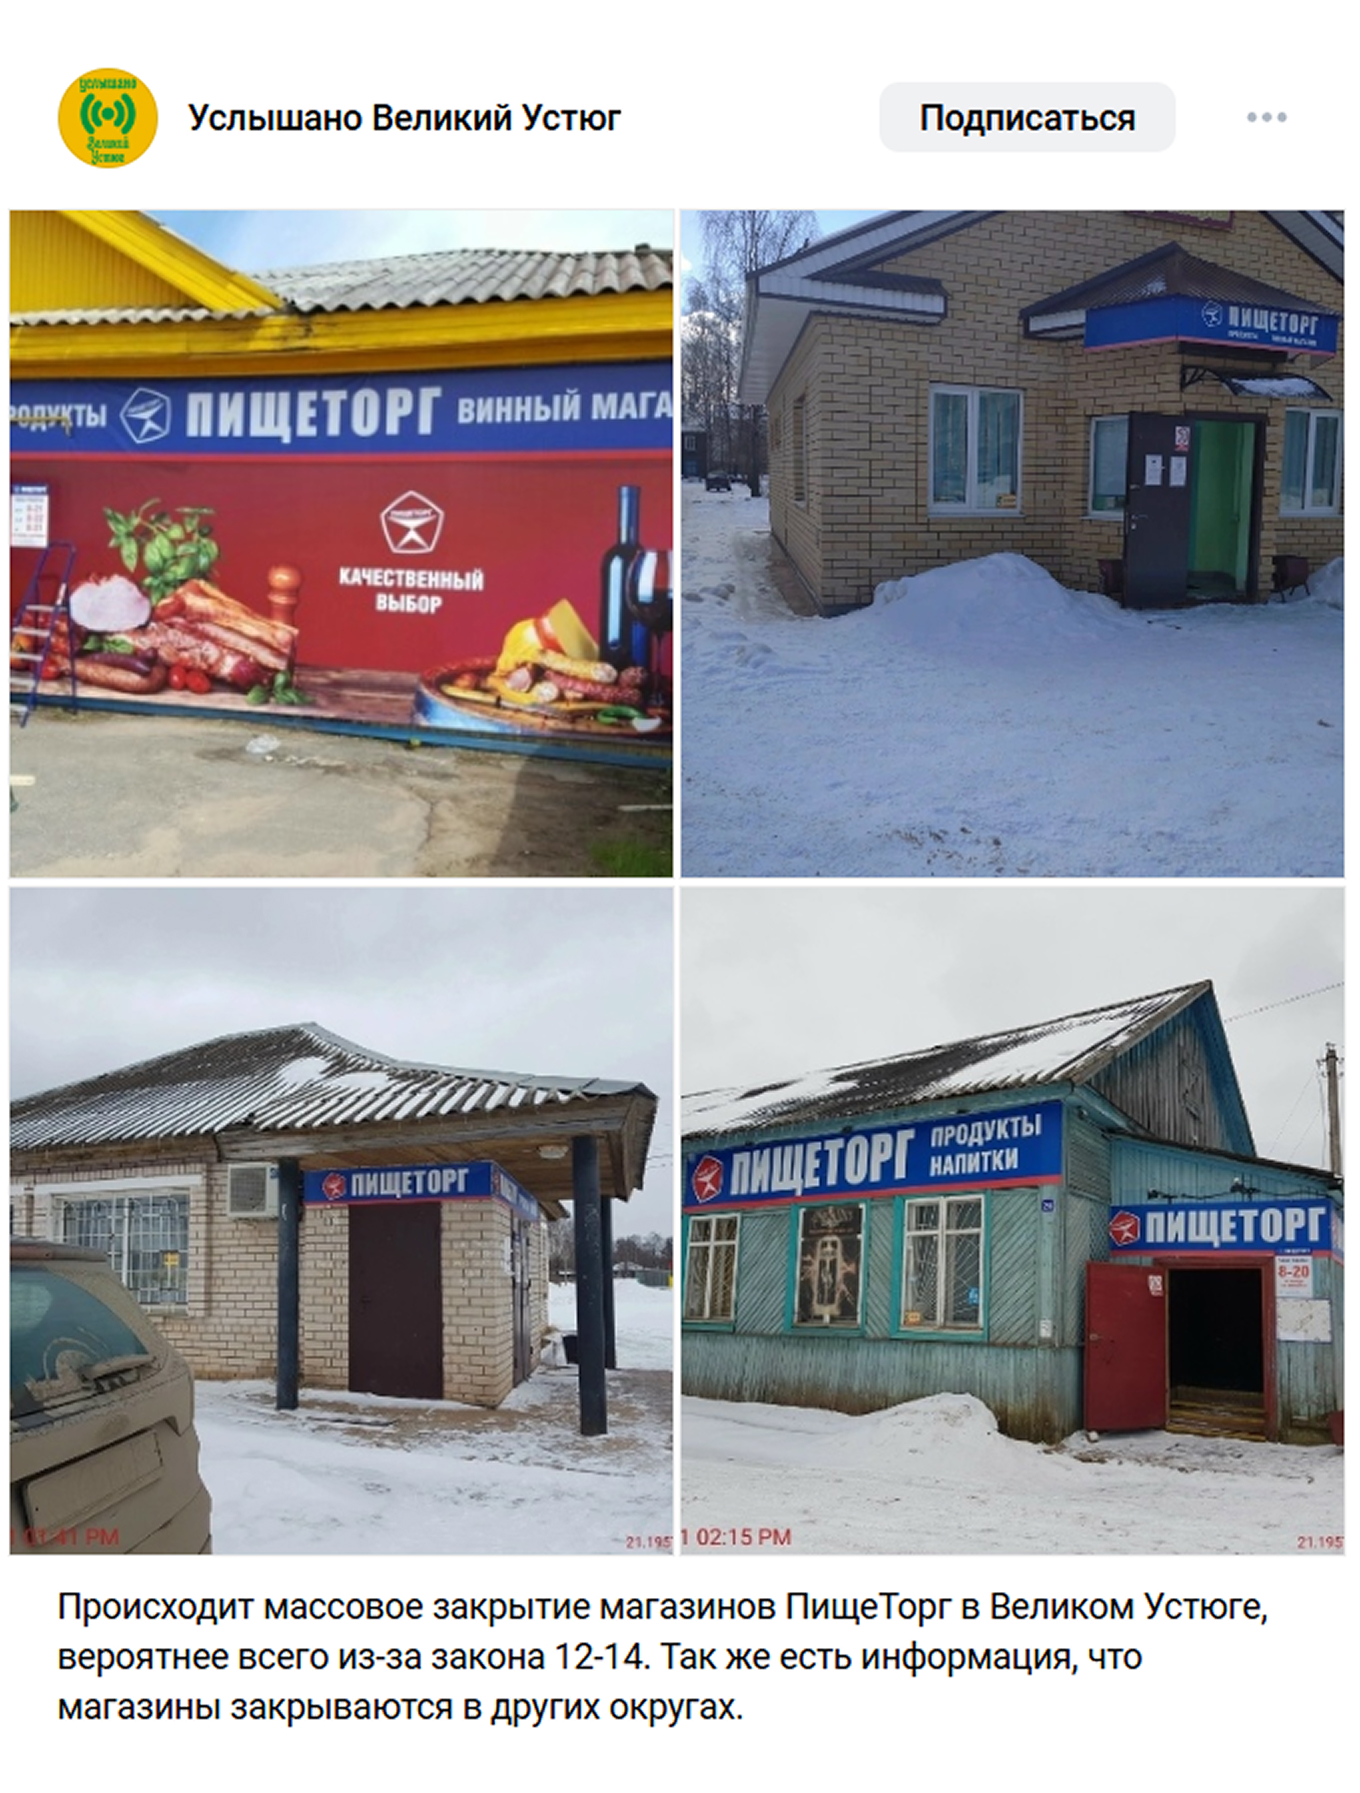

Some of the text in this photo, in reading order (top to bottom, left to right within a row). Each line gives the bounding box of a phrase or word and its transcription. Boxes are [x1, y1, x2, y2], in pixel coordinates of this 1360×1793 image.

[1228, 305, 1319, 336] ПИЩЕТОРГ
[186, 386, 442, 444] ПИЩЕТОРГ
[458, 388, 581, 424] ВИННЫЙ
[339, 566, 485, 592] КАЧЕСТВЕННЫЙ
[376, 592, 443, 615] ВЫБОР
[931, 1113, 1042, 1148] ПРОДУКТЫ
[730, 1128, 916, 1197] ПИЩЕТОРГ
[930, 1147, 1019, 1177] НАПИТКИ
[351, 1168, 470, 1199] ПИЩЕТОРГ
[1146, 1207, 1326, 1248] ПИЩЕТОРГ
[1278, 1264, 1310, 1278] 8-20
